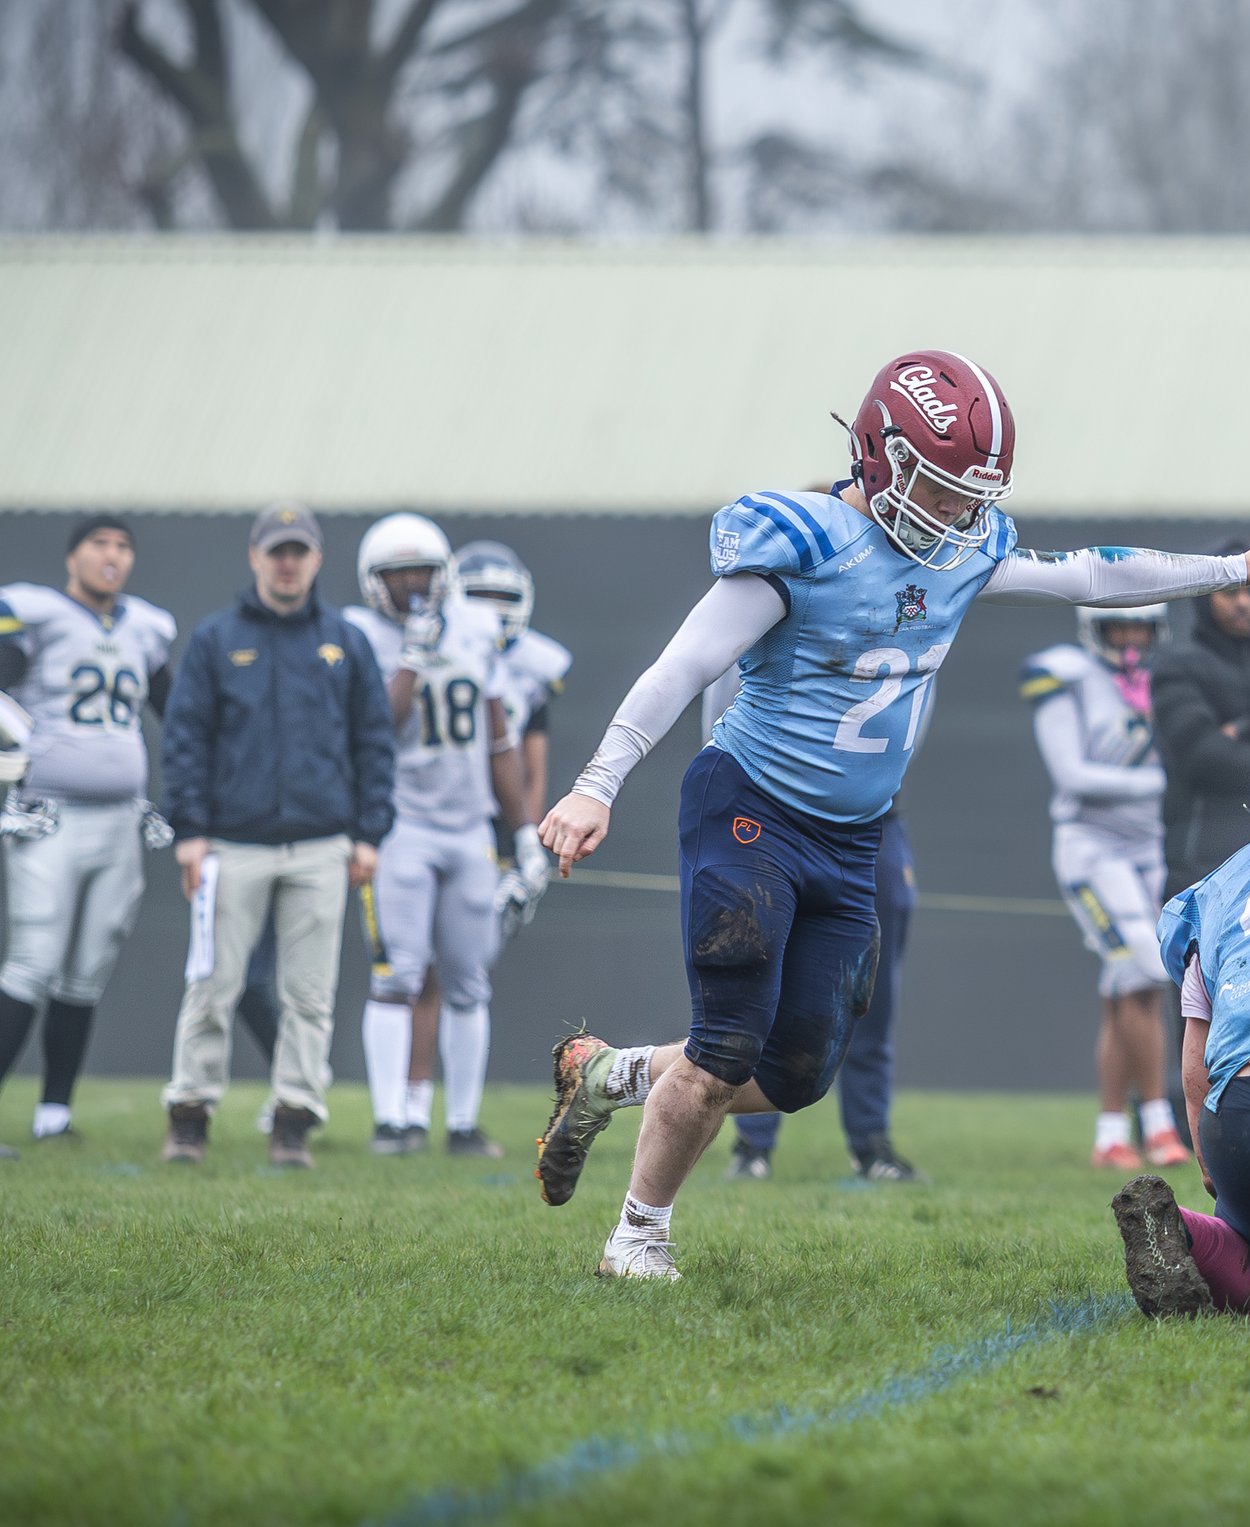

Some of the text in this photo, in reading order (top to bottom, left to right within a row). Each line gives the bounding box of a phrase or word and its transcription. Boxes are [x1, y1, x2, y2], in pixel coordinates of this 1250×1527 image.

[890, 366, 958, 433] Glads
[972, 468, 1002, 482] Riddell
[838, 545, 877, 573] AKUMA
[69, 664, 140, 727] 26
[421, 677, 479, 747] 18
[832, 643, 951, 753] 21
[737, 821, 751, 832] PL
